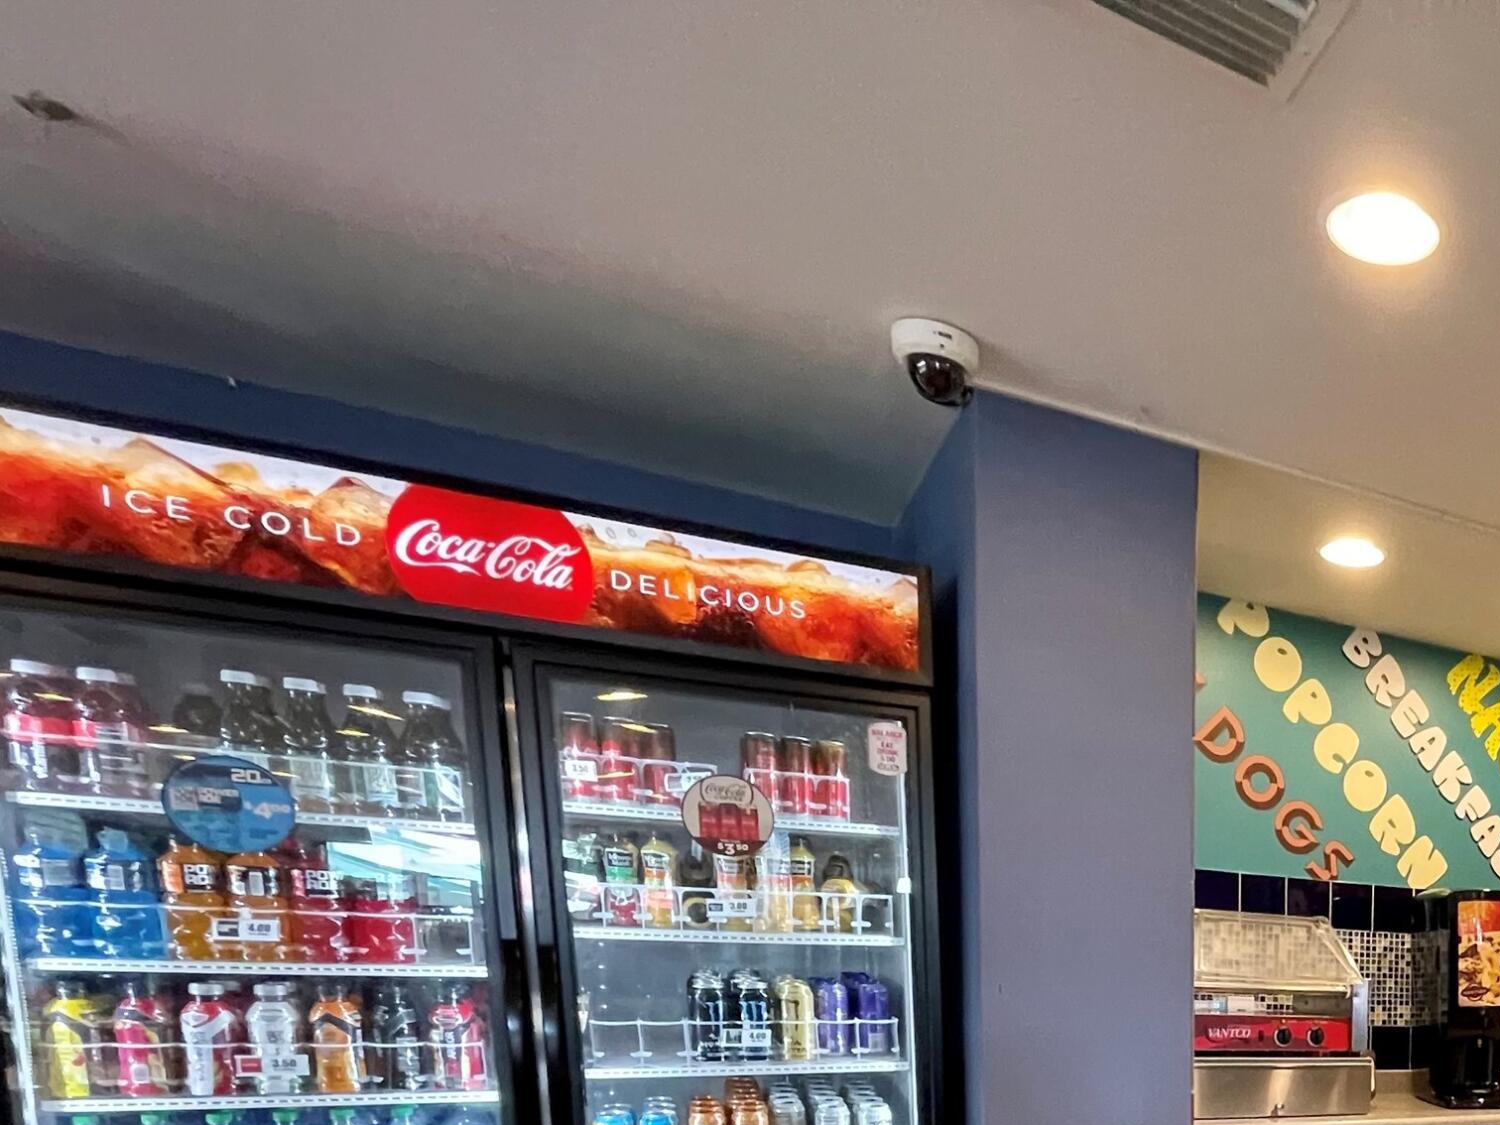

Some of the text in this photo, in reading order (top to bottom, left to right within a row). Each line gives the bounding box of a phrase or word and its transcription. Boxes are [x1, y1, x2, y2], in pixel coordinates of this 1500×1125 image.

[101, 484, 361, 547] ICE COLD
[395, 519, 582, 591] Coca-Cola
[610, 569, 806, 620] DELICIOUS
[1193, 705, 1356, 882] DOGS
